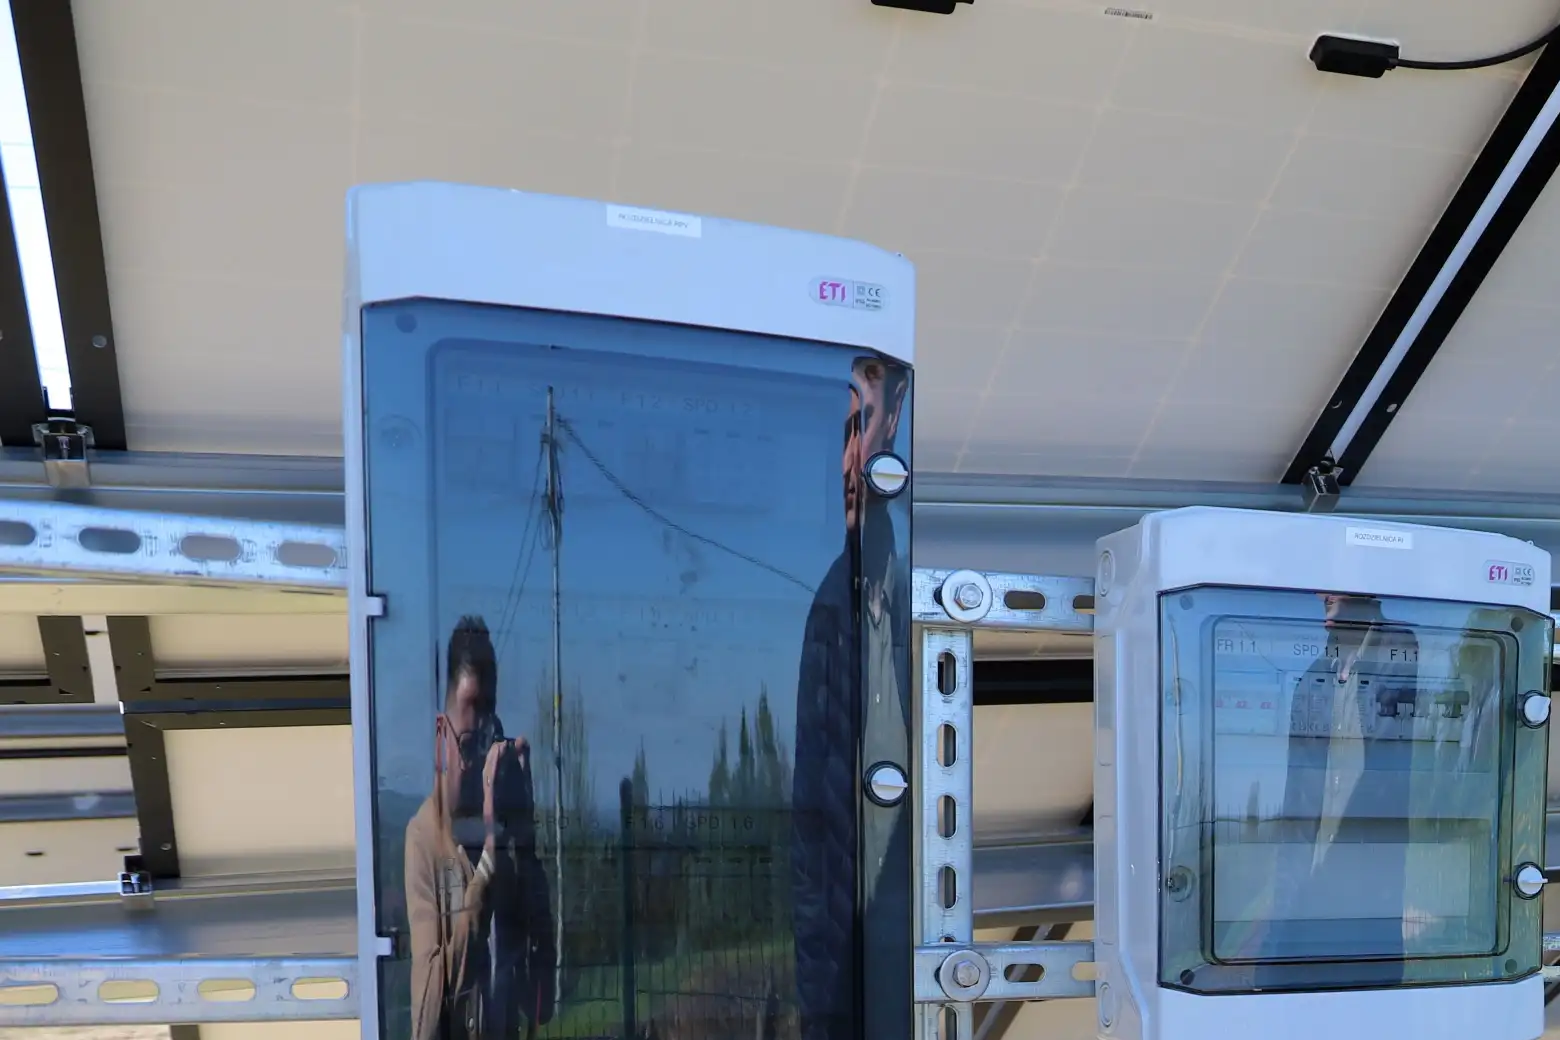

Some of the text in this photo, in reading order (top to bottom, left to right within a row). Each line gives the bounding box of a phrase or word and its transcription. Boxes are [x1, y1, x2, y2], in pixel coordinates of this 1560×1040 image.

[819, 281, 846, 302] ETI
[1489, 565, 1508, 581] ETI
[1217, 638, 1234, 653] FR
[1293, 644, 1339, 658] SPD 1.1
[1390, 648, 1418, 662] F 1.1
